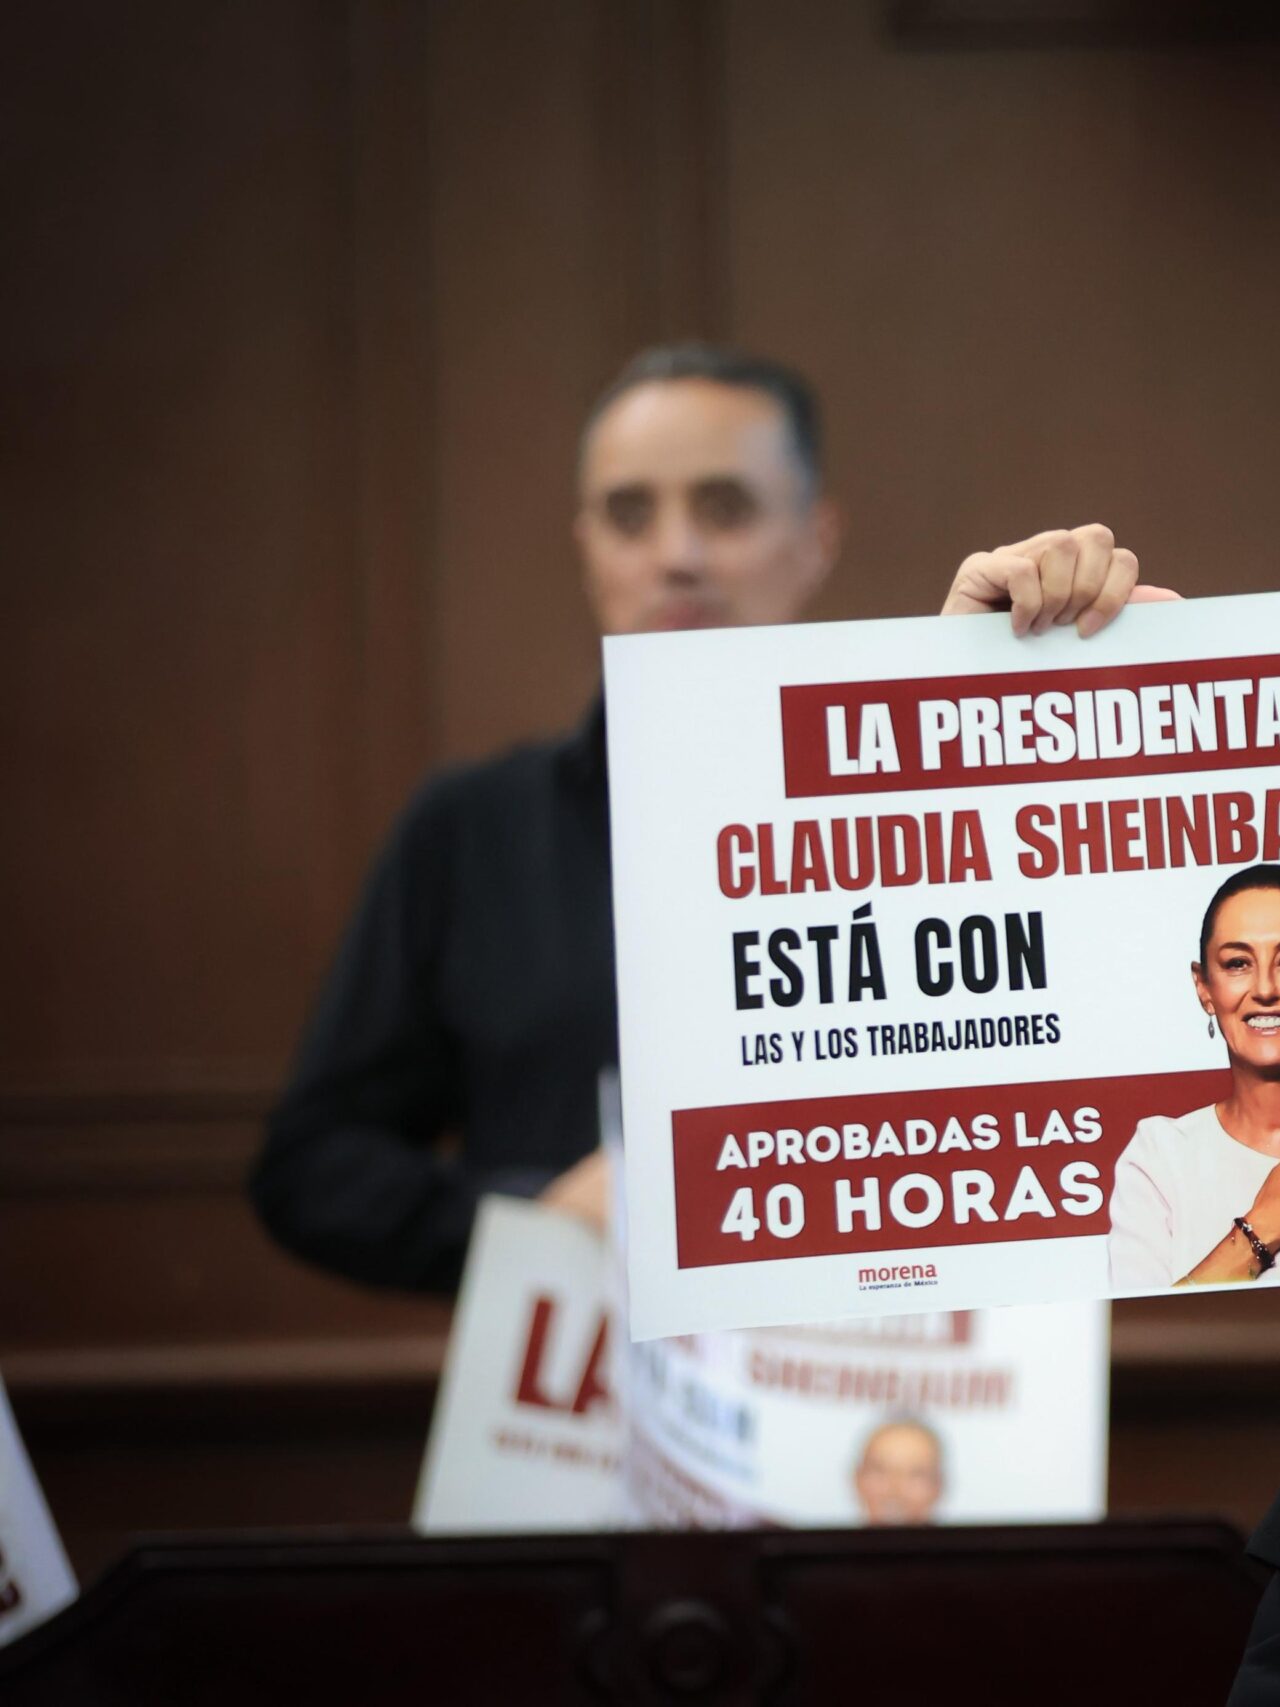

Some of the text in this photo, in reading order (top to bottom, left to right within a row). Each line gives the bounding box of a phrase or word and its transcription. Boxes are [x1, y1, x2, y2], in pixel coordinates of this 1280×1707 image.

[826, 703, 901, 776] LA
[716, 809, 993, 900] CLAUDIA
[732, 902, 1047, 1011] ESTÁ CON
[741, 1013, 1061, 1066] LAS Y LOS TRABAJADORES
[716, 1106, 1103, 1171] APROBADAS LAS
[721, 1161, 1104, 1241] 40 HORAS
[858, 1263, 937, 1283] morena
[868, 1283, 902, 1291] esperanza
